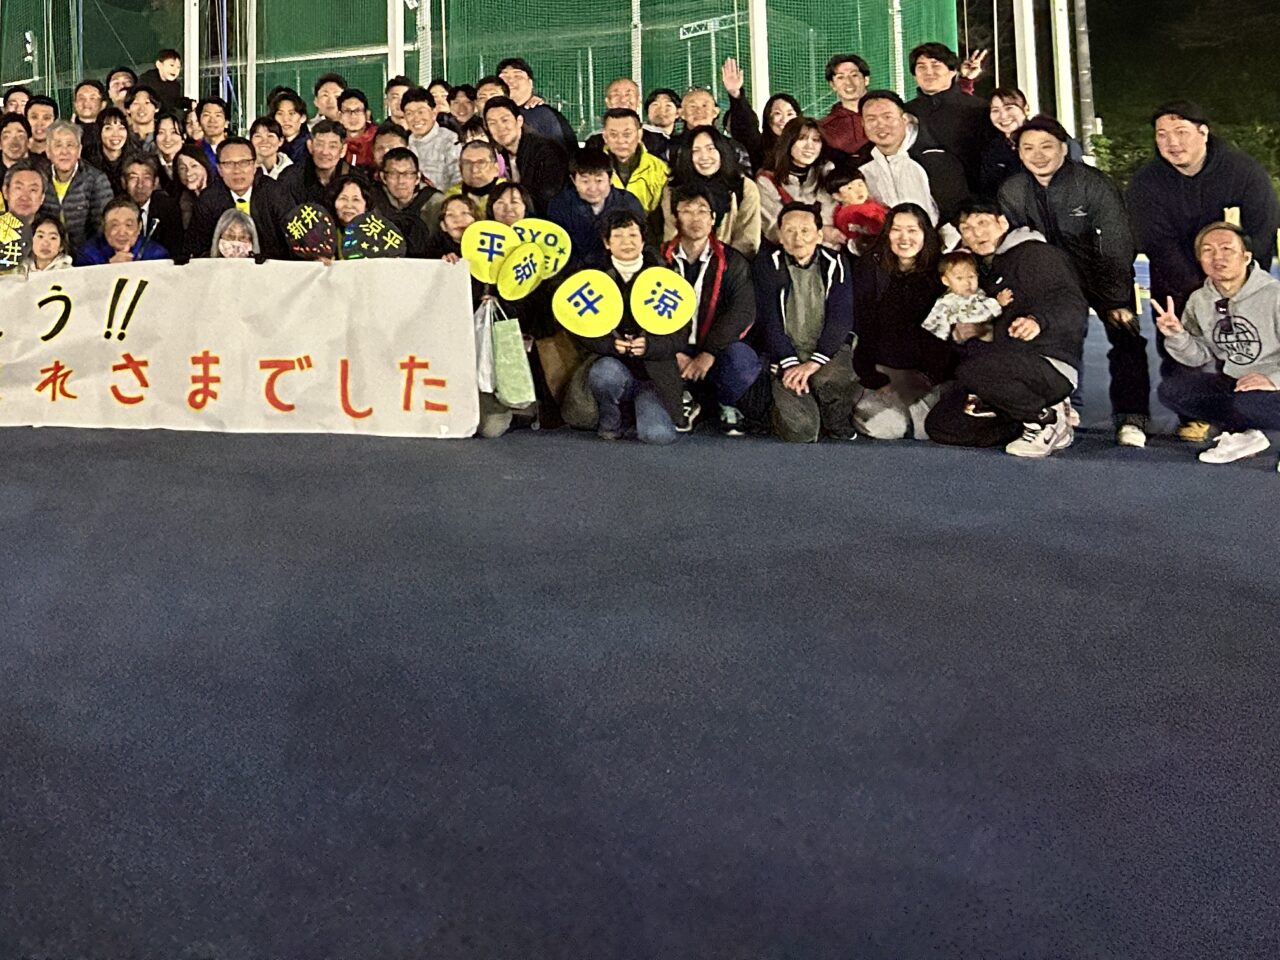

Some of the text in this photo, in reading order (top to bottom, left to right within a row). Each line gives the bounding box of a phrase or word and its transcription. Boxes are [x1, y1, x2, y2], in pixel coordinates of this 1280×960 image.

[287, 205, 319, 240] 新井
[513, 226, 558, 247] RYO
[477, 231, 506, 262] 平
[567, 281, 604, 317] 平
[644, 281, 684, 319] 涼
